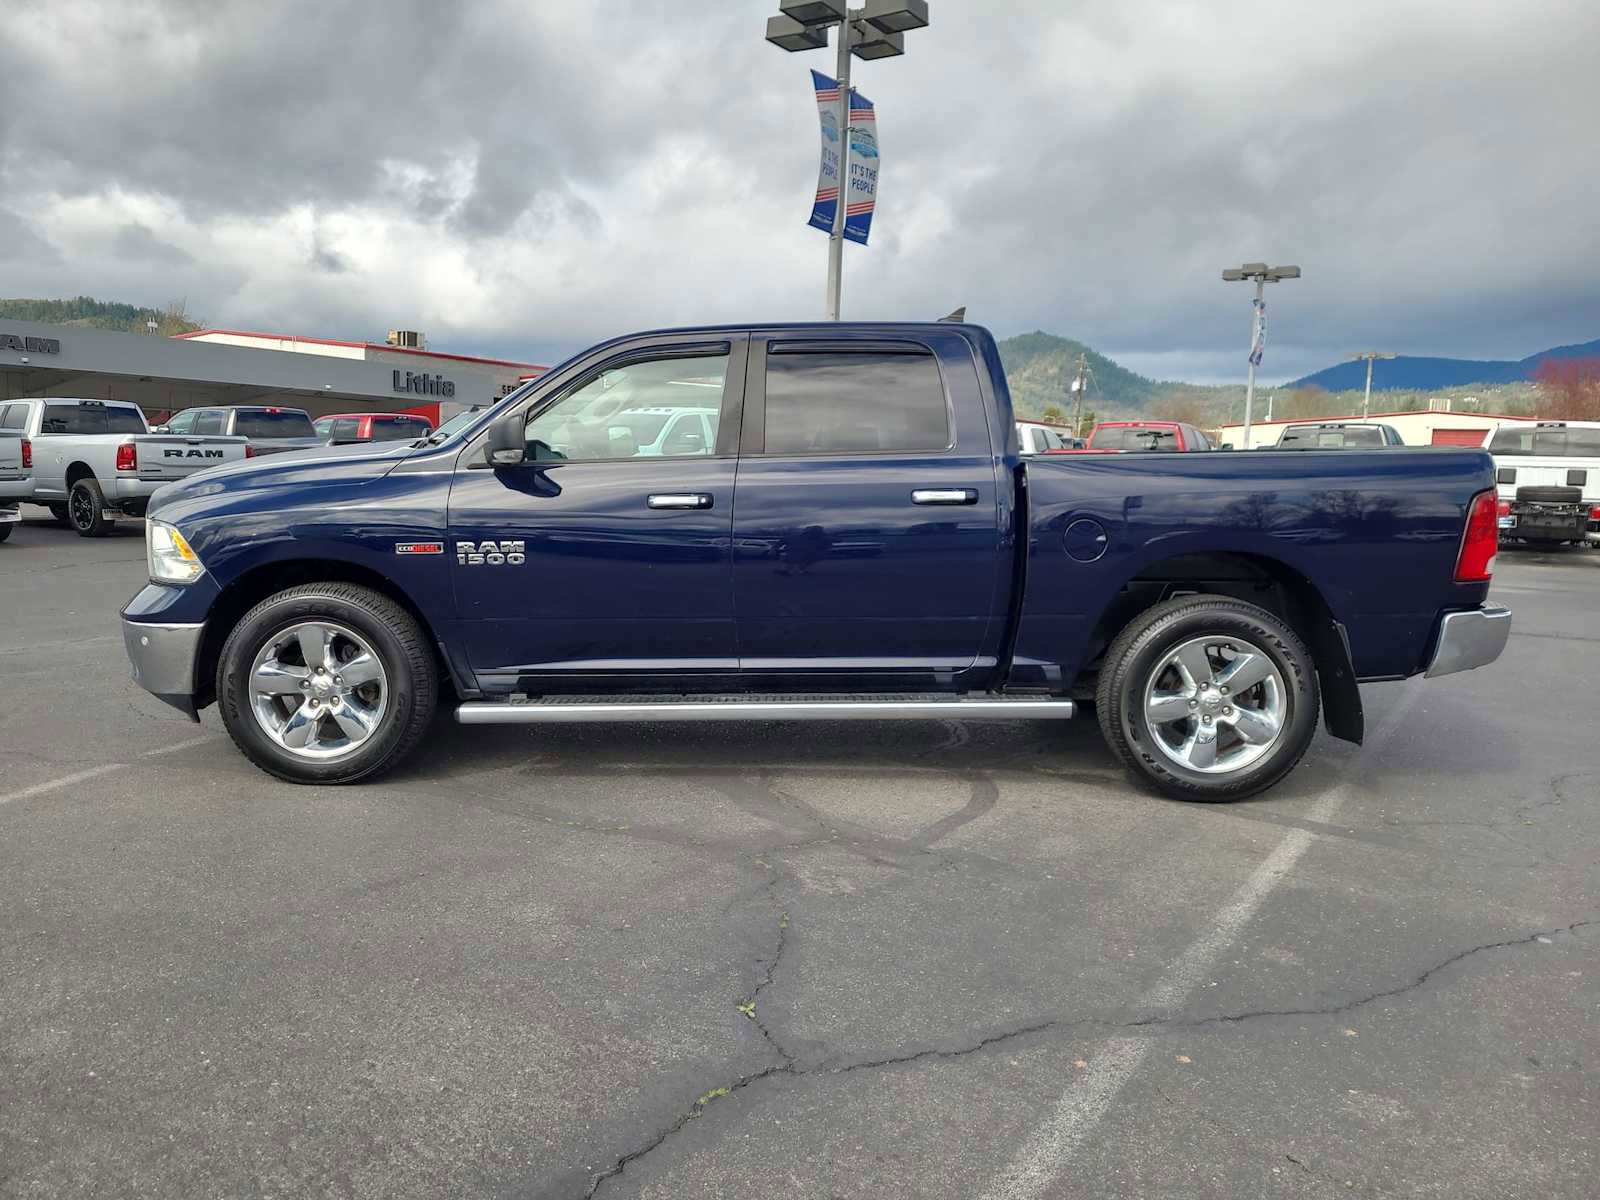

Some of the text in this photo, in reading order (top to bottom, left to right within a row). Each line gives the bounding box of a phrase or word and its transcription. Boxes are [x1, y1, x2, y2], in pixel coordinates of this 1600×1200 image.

[865, 167, 877, 182] THE
[852, 177, 874, 195] PEOPLE
[393, 369, 455, 398] Lithia
[163, 449, 224, 458] RAM
[456, 541, 525, 553] RAM
[456, 553, 526, 565] 1500
